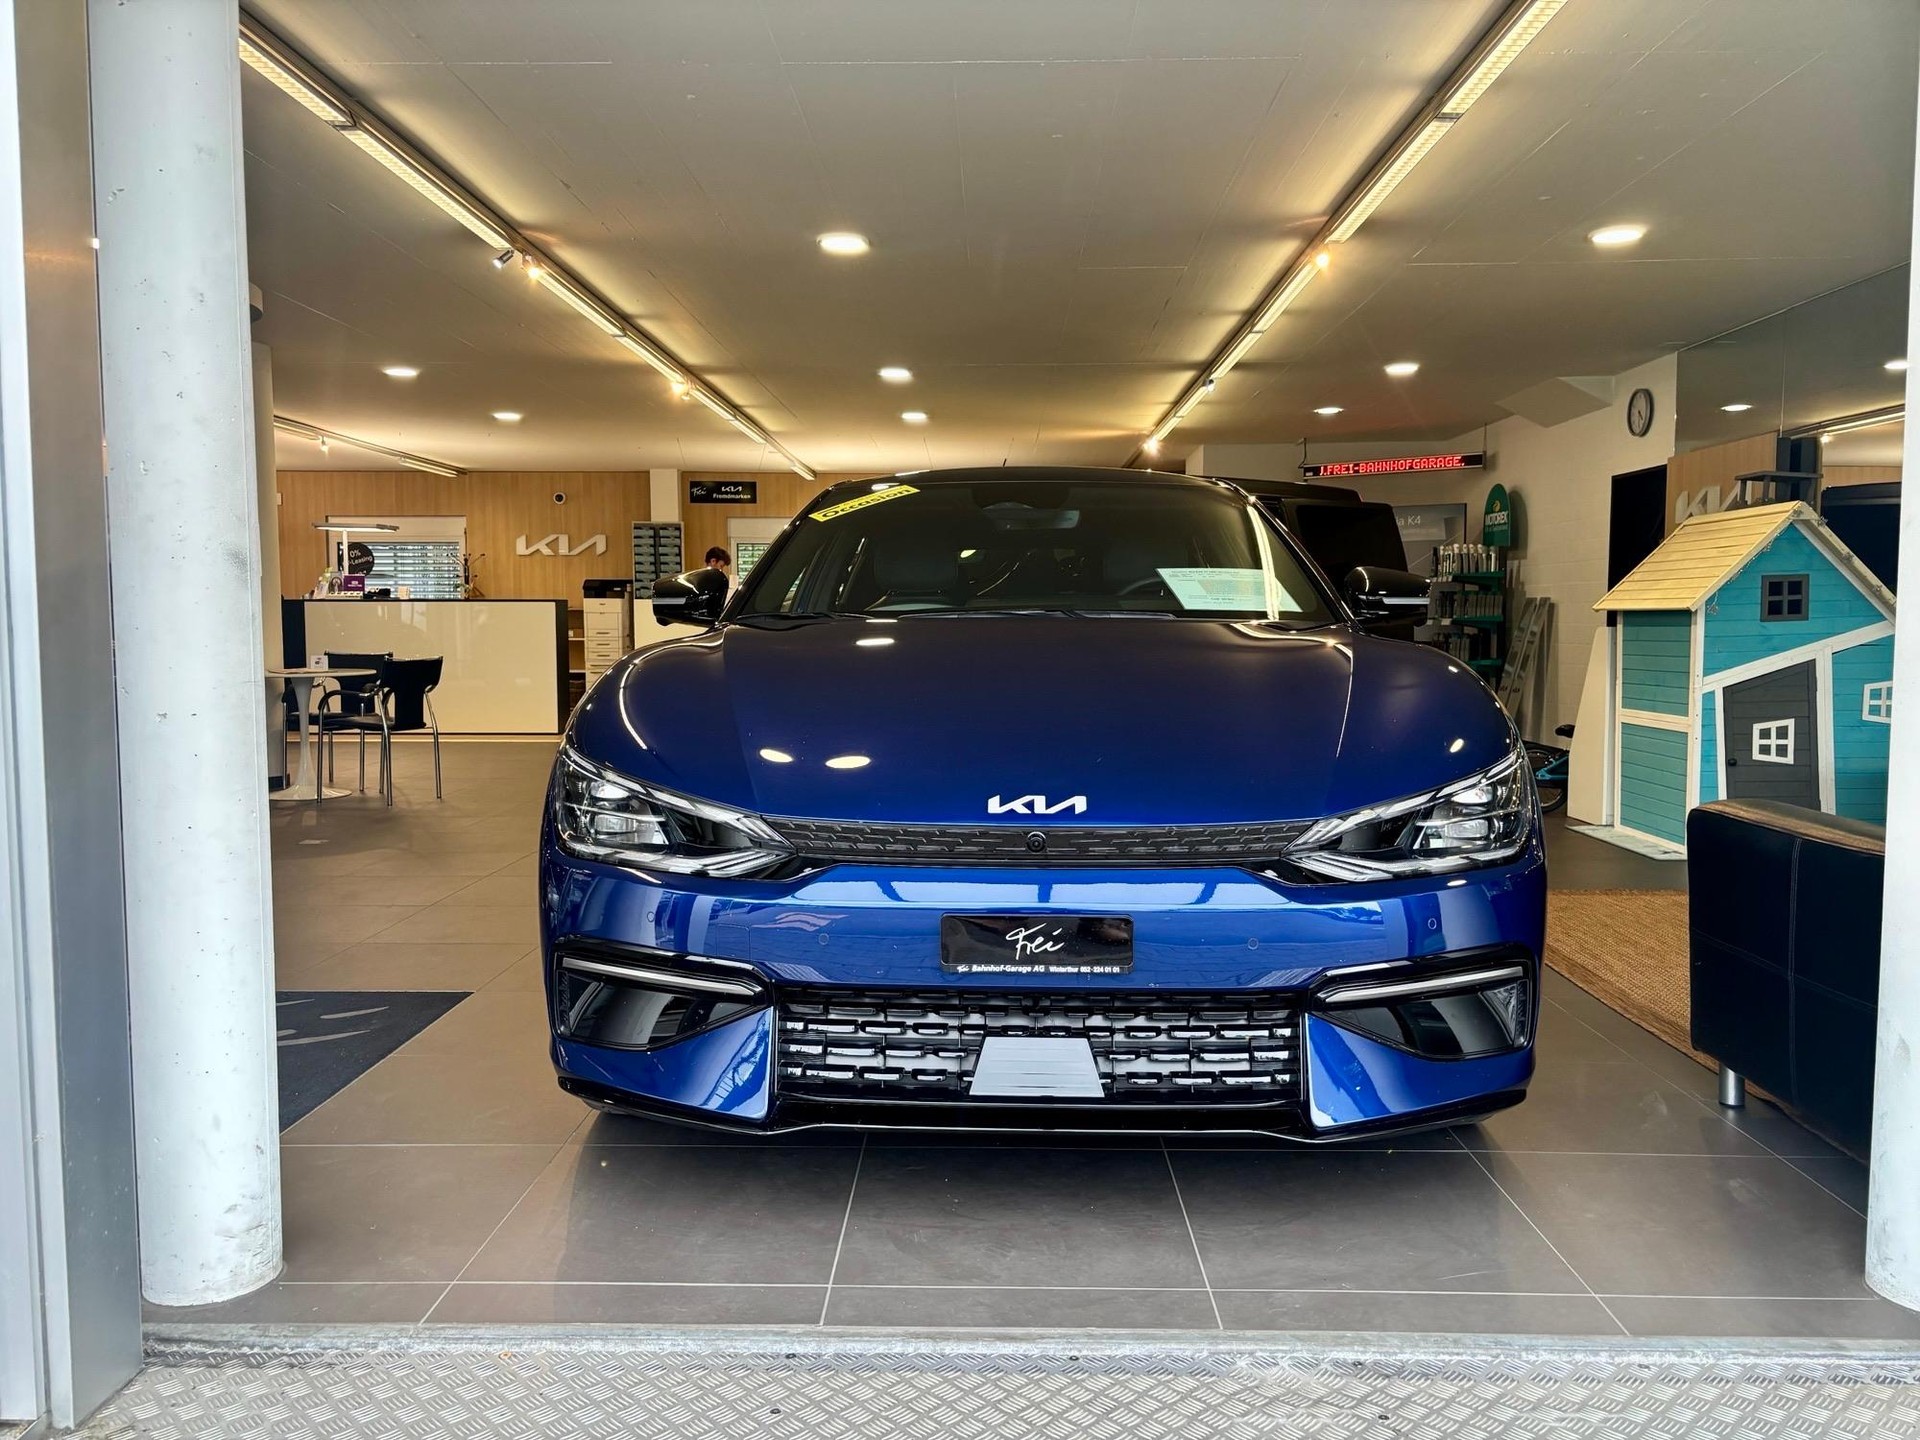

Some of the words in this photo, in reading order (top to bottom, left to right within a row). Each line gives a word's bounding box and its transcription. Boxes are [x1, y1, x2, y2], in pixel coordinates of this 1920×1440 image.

[821, 489, 911, 518] Occasion
[1407, 515, 1421, 526] K4
[1485, 511, 1508, 526] MOTOREX
[516, 534, 607, 556] KIA
[987, 795, 1087, 815] KIA
[971, 965, 1032, 974] Bahnhof-Garage
